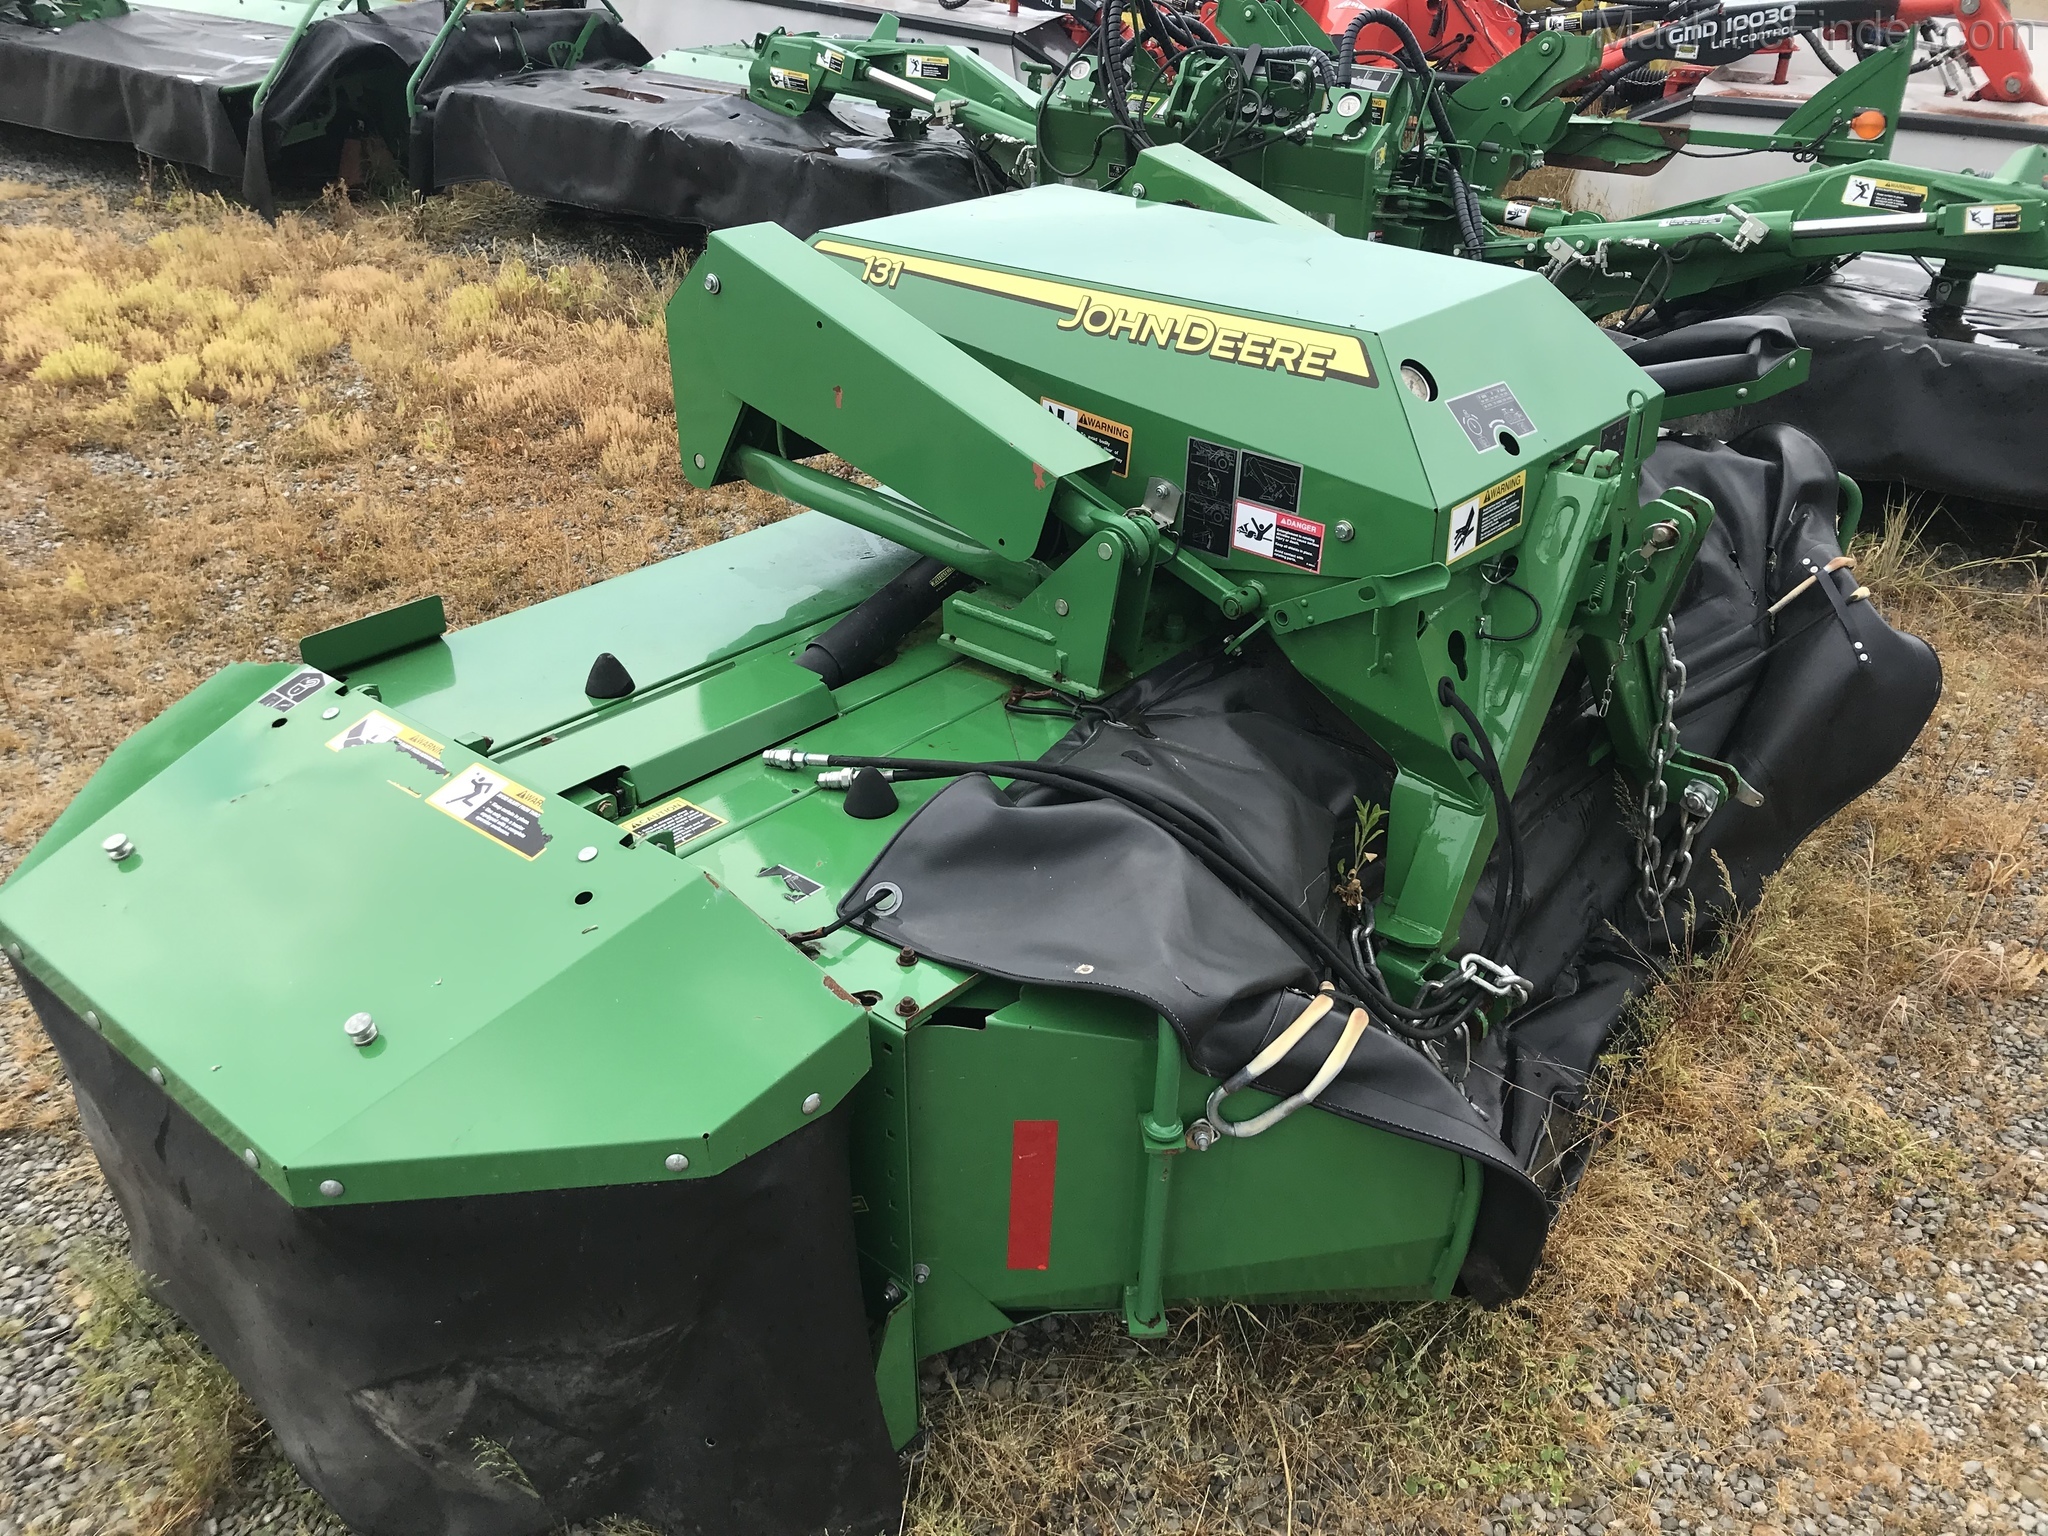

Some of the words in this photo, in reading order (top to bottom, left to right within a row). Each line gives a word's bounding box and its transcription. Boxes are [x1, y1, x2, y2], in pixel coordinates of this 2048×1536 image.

[1669, 21, 1718, 44] GMD
[1727, 4, 1796, 32] 10030
[1711, 36, 1739, 49] LIFT
[1740, 25, 1798, 43] CONTROL
[861, 255, 904, 289] 131
[1057, 295, 1177, 350] JOHN
[1174, 314, 1337, 381] DEERE
[1087, 416, 1129, 439] WARNING
[1490, 475, 1521, 500] WARNING
[1286, 519, 1316, 533] DANGER
[640, 803, 682, 826] CAUTION
